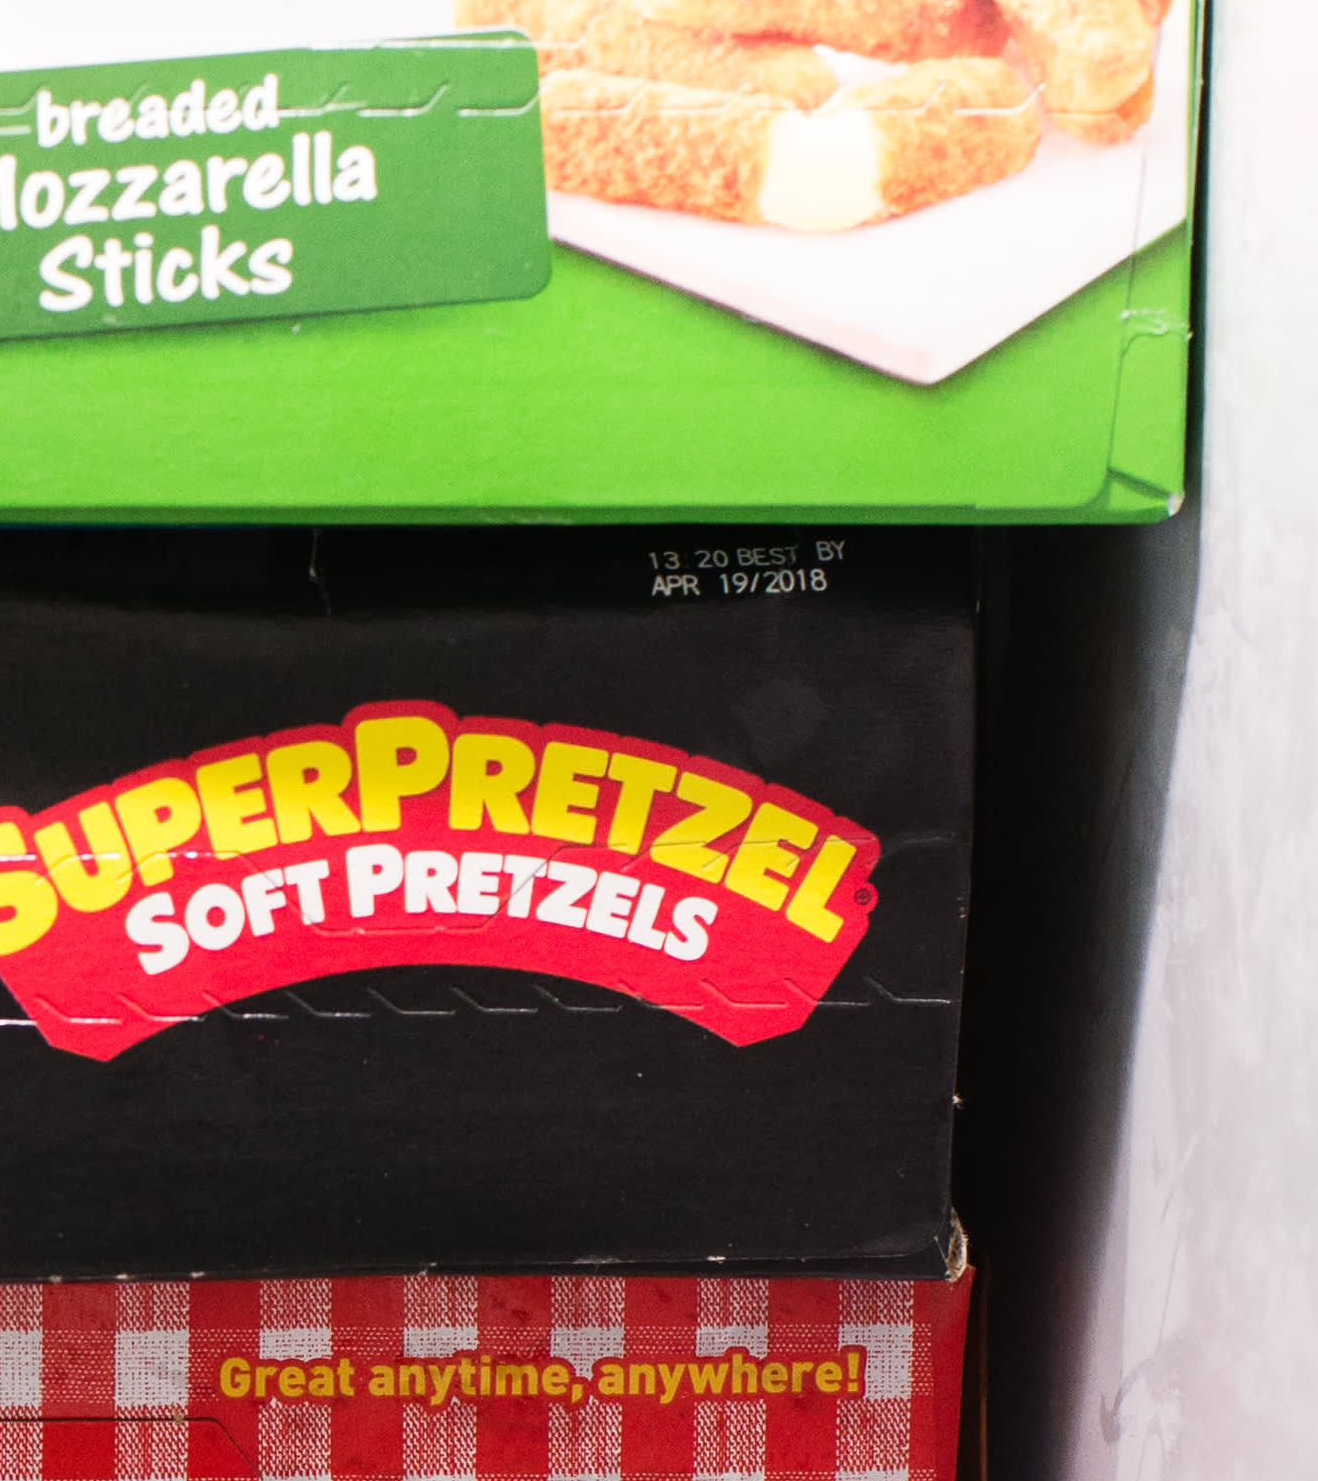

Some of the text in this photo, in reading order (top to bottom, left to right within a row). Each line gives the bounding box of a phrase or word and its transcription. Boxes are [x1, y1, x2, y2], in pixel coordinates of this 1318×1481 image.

[34, 75, 281, 149] breaded
[37, 225, 294, 312] Sticks
[651, 568, 828, 596] APR 19/2018
[736, 545, 798, 567] BEST
[814, 540, 846, 562] BY
[124, 843, 719, 977] SOFT PRETZELS
[219, 1349, 864, 1407] Great anytime, anywhere!
